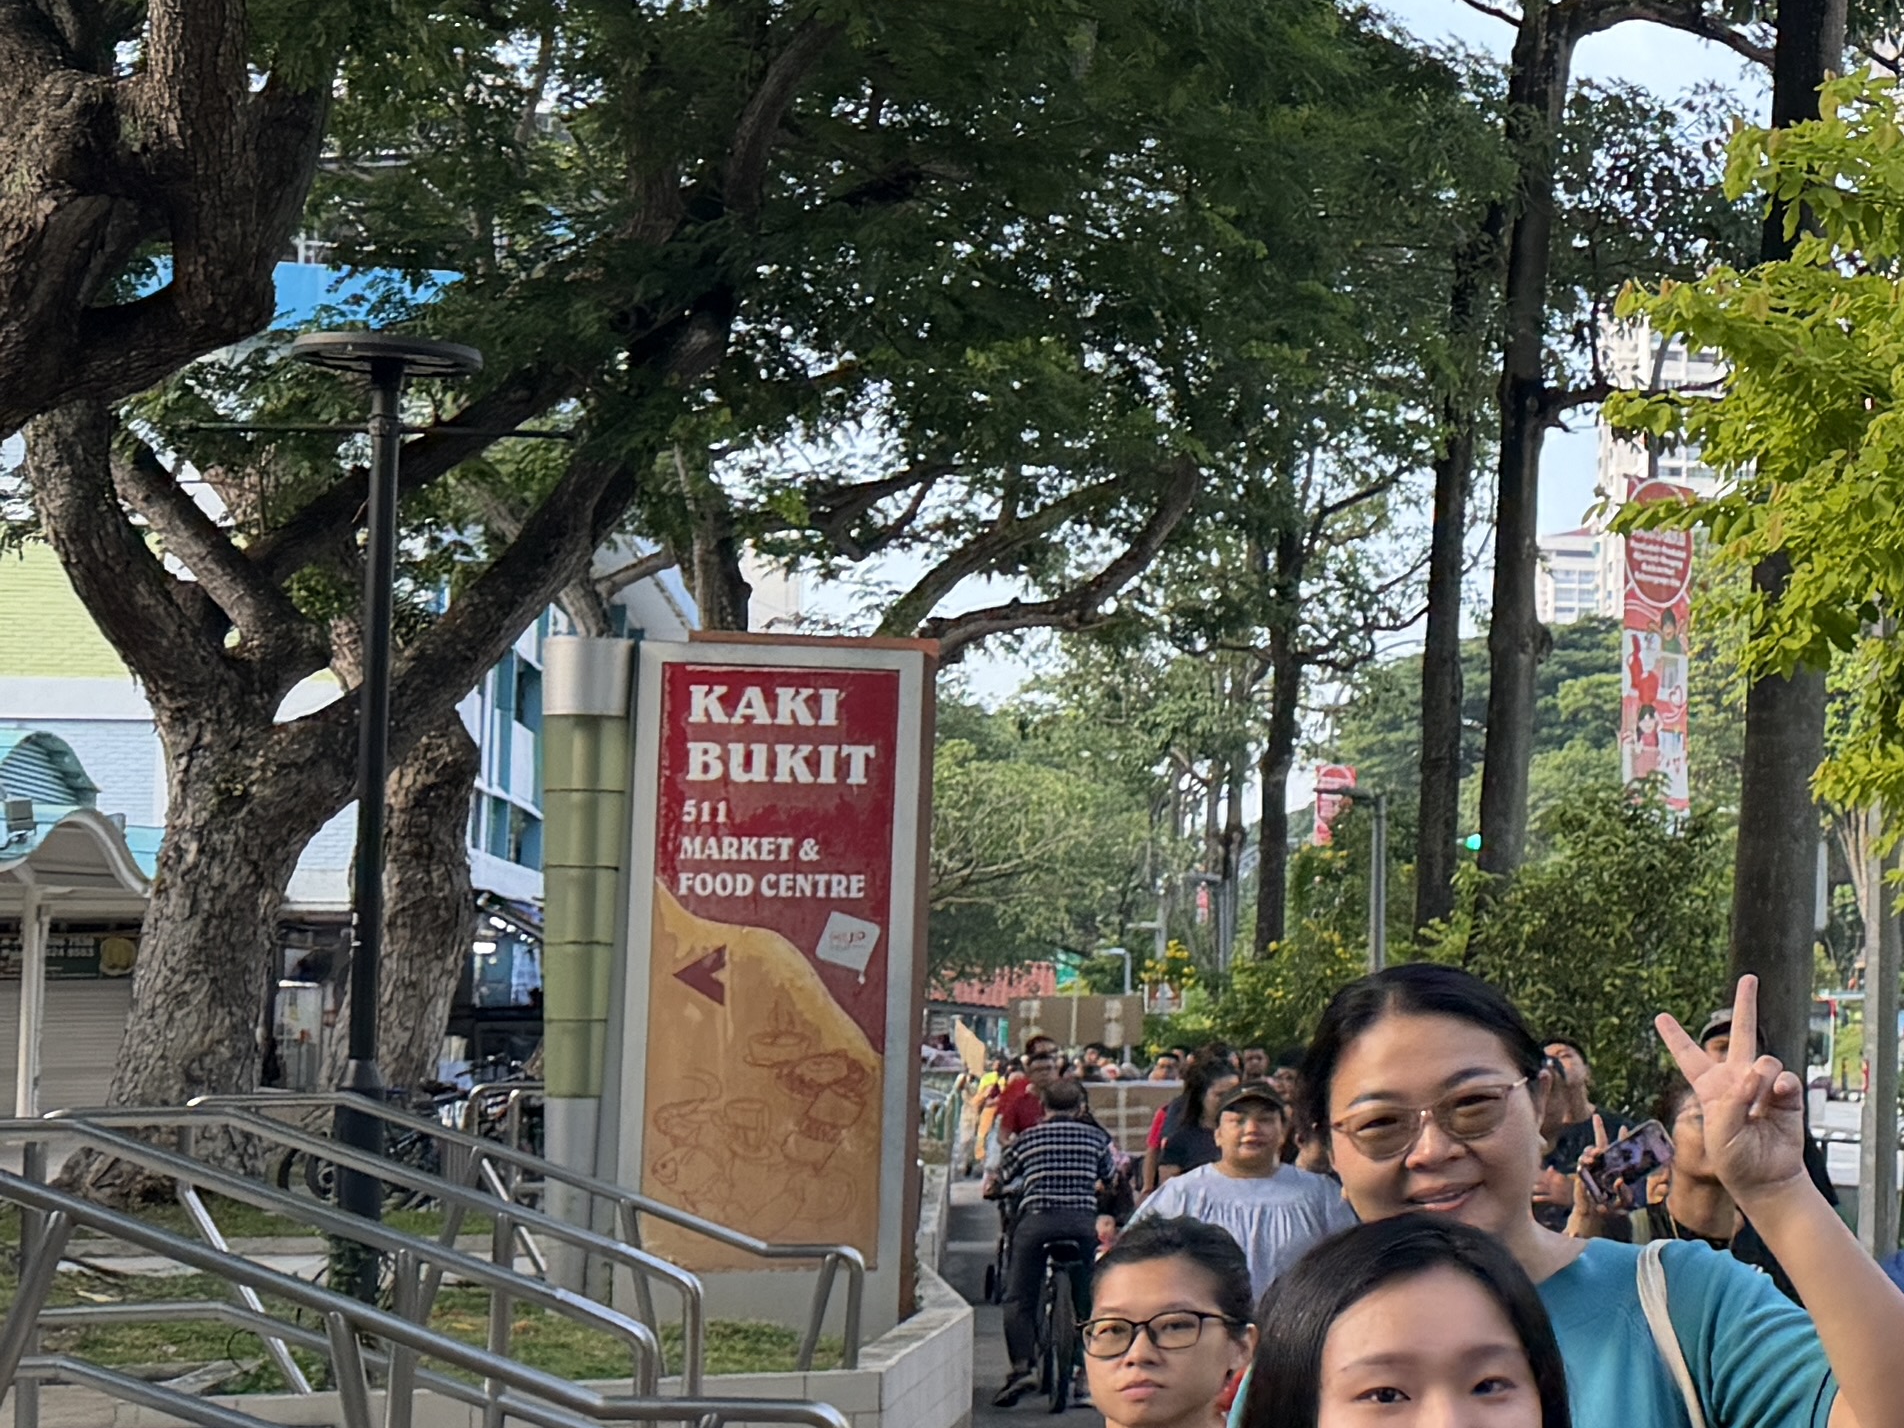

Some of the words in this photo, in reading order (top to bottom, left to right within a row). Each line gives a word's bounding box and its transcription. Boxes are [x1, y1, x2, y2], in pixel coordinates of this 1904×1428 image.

[688, 684, 840, 726] KAKI
[686, 741, 876, 784] BUKIT
[682, 799, 728, 823] 511
[679, 835, 794, 862] MARKET
[798, 837, 821, 862] &
[678, 871, 755, 897] FOOD
[760, 873, 866, 899] CENTRE
